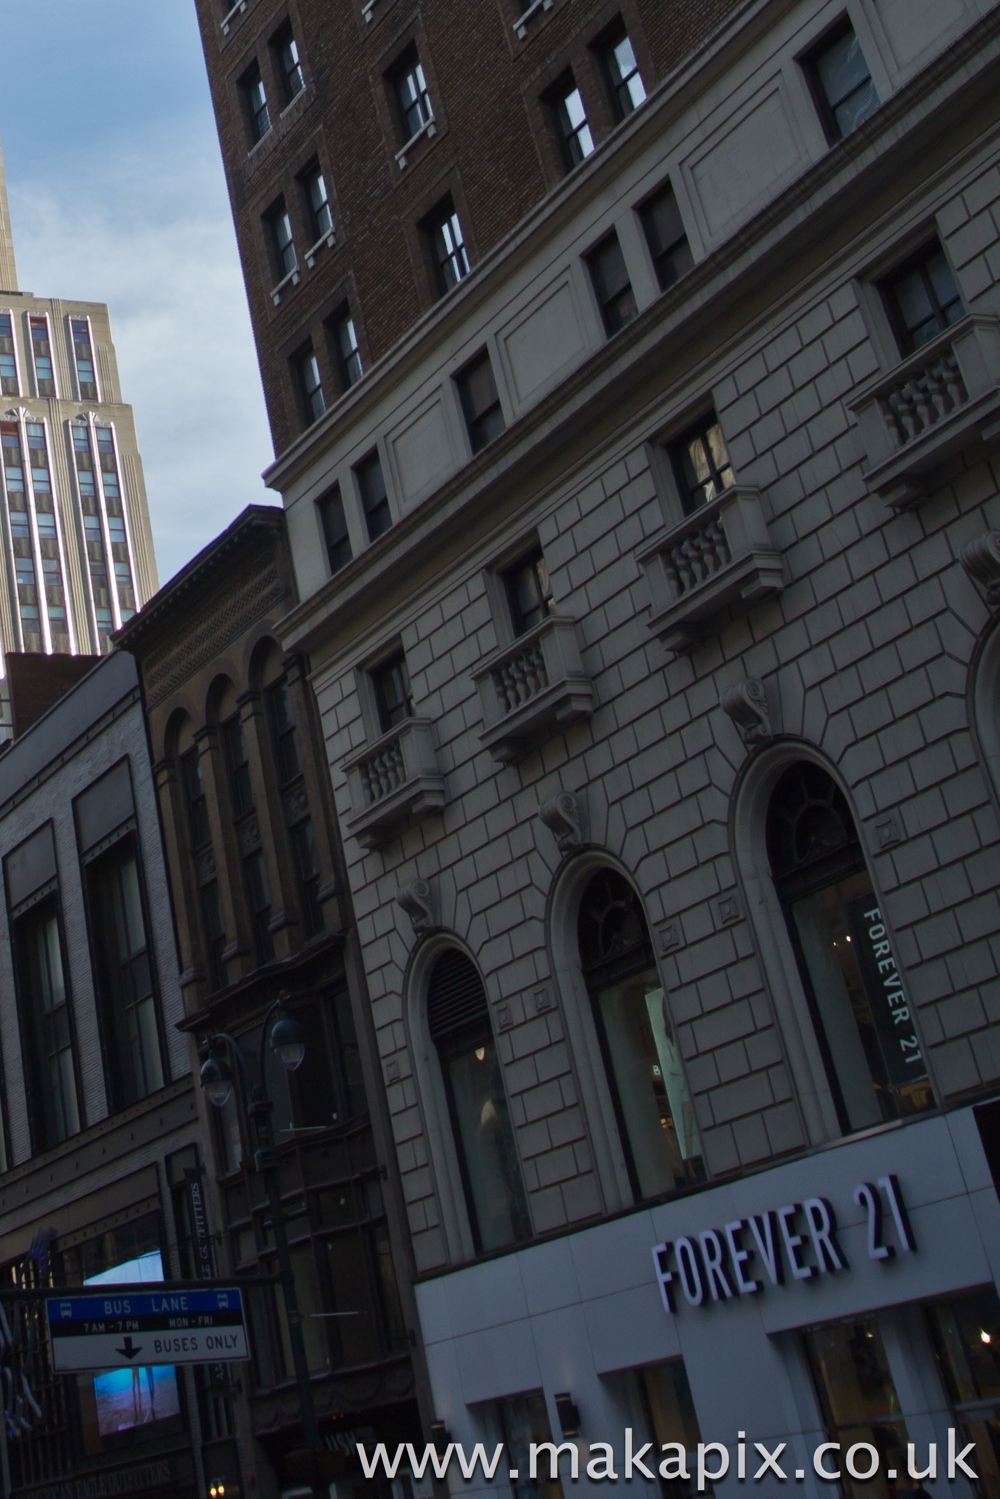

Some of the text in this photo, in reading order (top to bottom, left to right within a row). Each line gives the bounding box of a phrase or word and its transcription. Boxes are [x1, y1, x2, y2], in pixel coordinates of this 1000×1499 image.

[863, 907, 923, 1064] FOREVER 21
[651, 1174, 915, 1314] FOREVER 21
[103, 1296, 189, 1316] BUS LANE
[154, 1334, 239, 1354] BUSES ONLY
